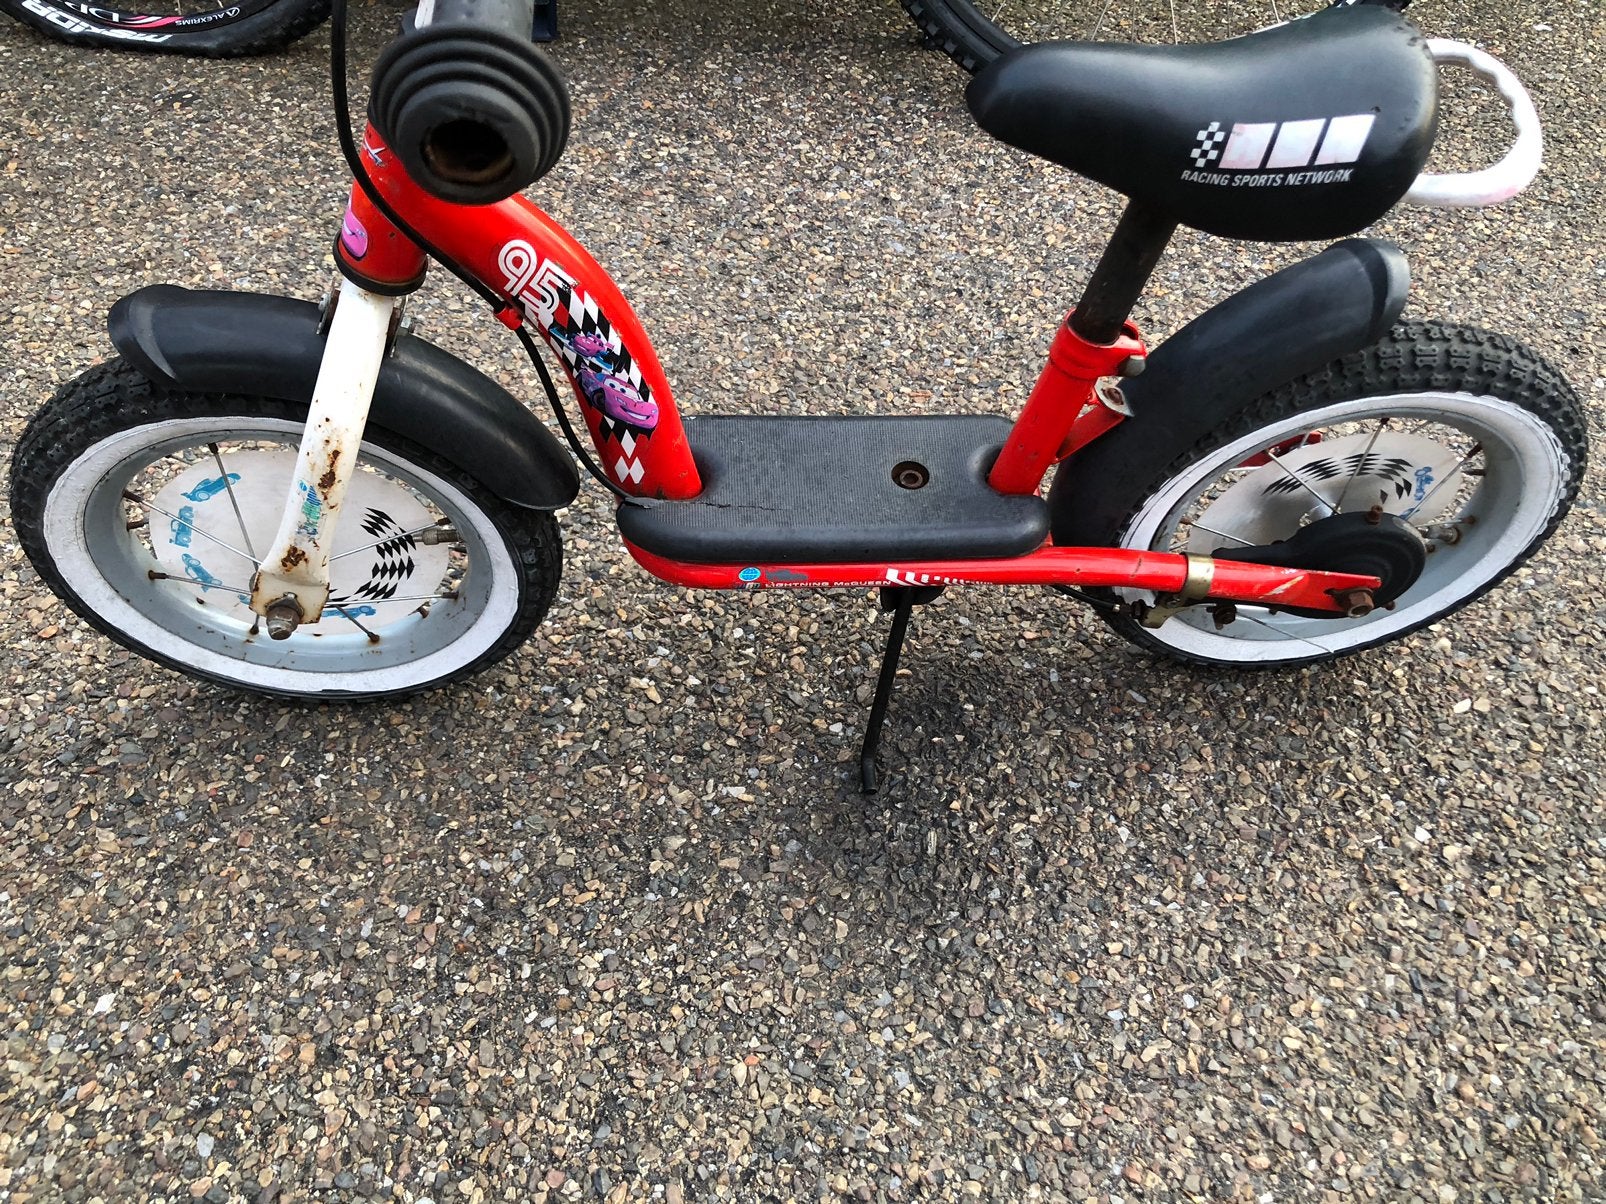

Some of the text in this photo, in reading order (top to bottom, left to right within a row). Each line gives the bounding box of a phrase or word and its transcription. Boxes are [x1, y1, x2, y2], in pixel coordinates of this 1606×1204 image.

[175, 13, 225, 26] ALEXRIMS
[1181, 168, 1354, 187] RACING SPORTS NETWORK
[497, 239, 578, 313] 95
